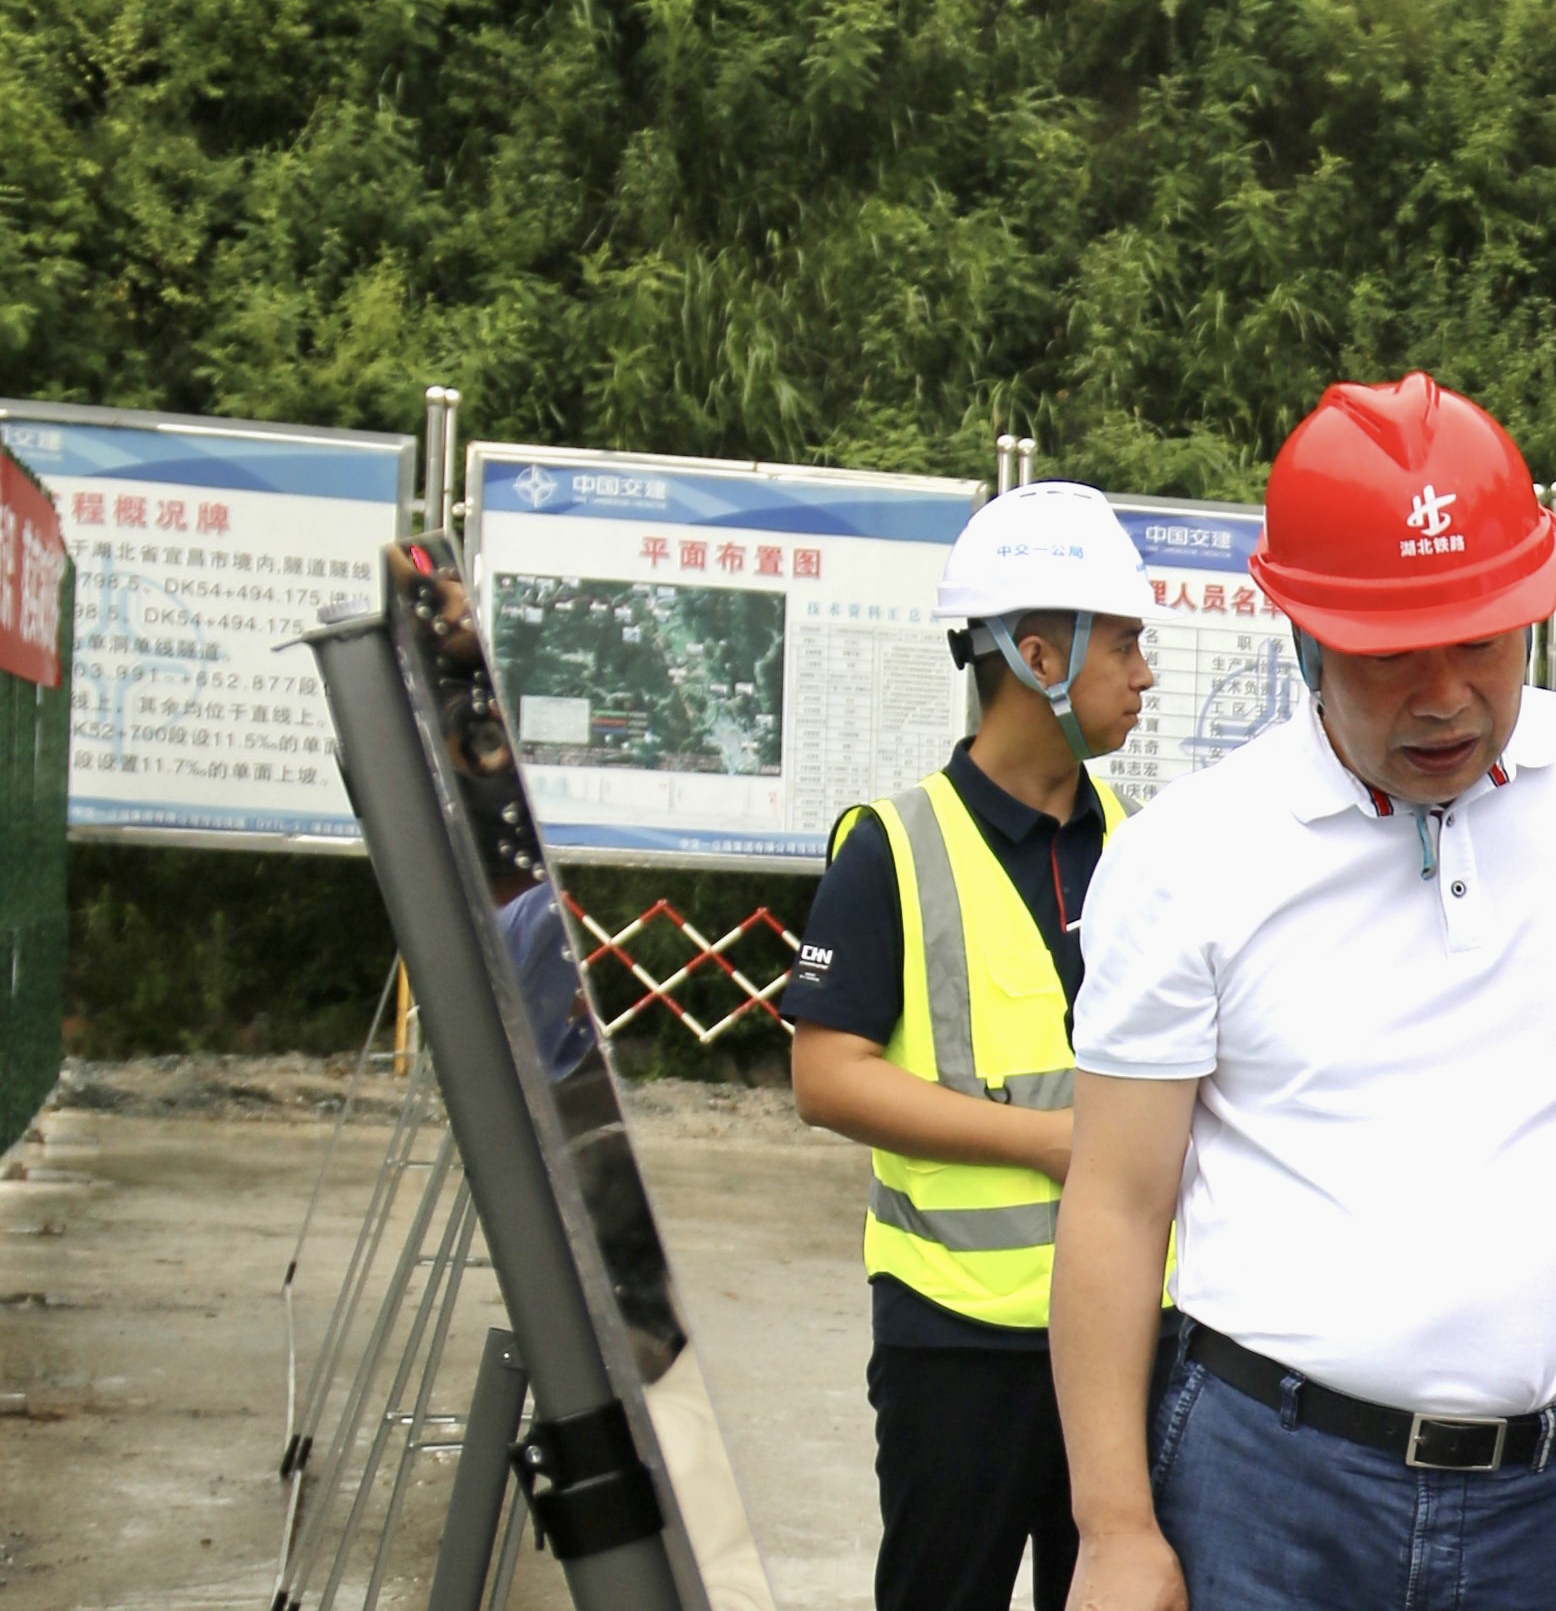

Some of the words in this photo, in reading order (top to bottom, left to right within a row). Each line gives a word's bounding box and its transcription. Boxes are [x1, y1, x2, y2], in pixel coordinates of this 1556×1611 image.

[572, 474, 666, 499] 中国交建
[1145, 525, 1232, 550] 中国交建
[1400, 535, 1465, 557] 湖北铁路
[640, 536, 823, 580] 平面布置图
[996, 544, 1084, 559] 中交一公局
